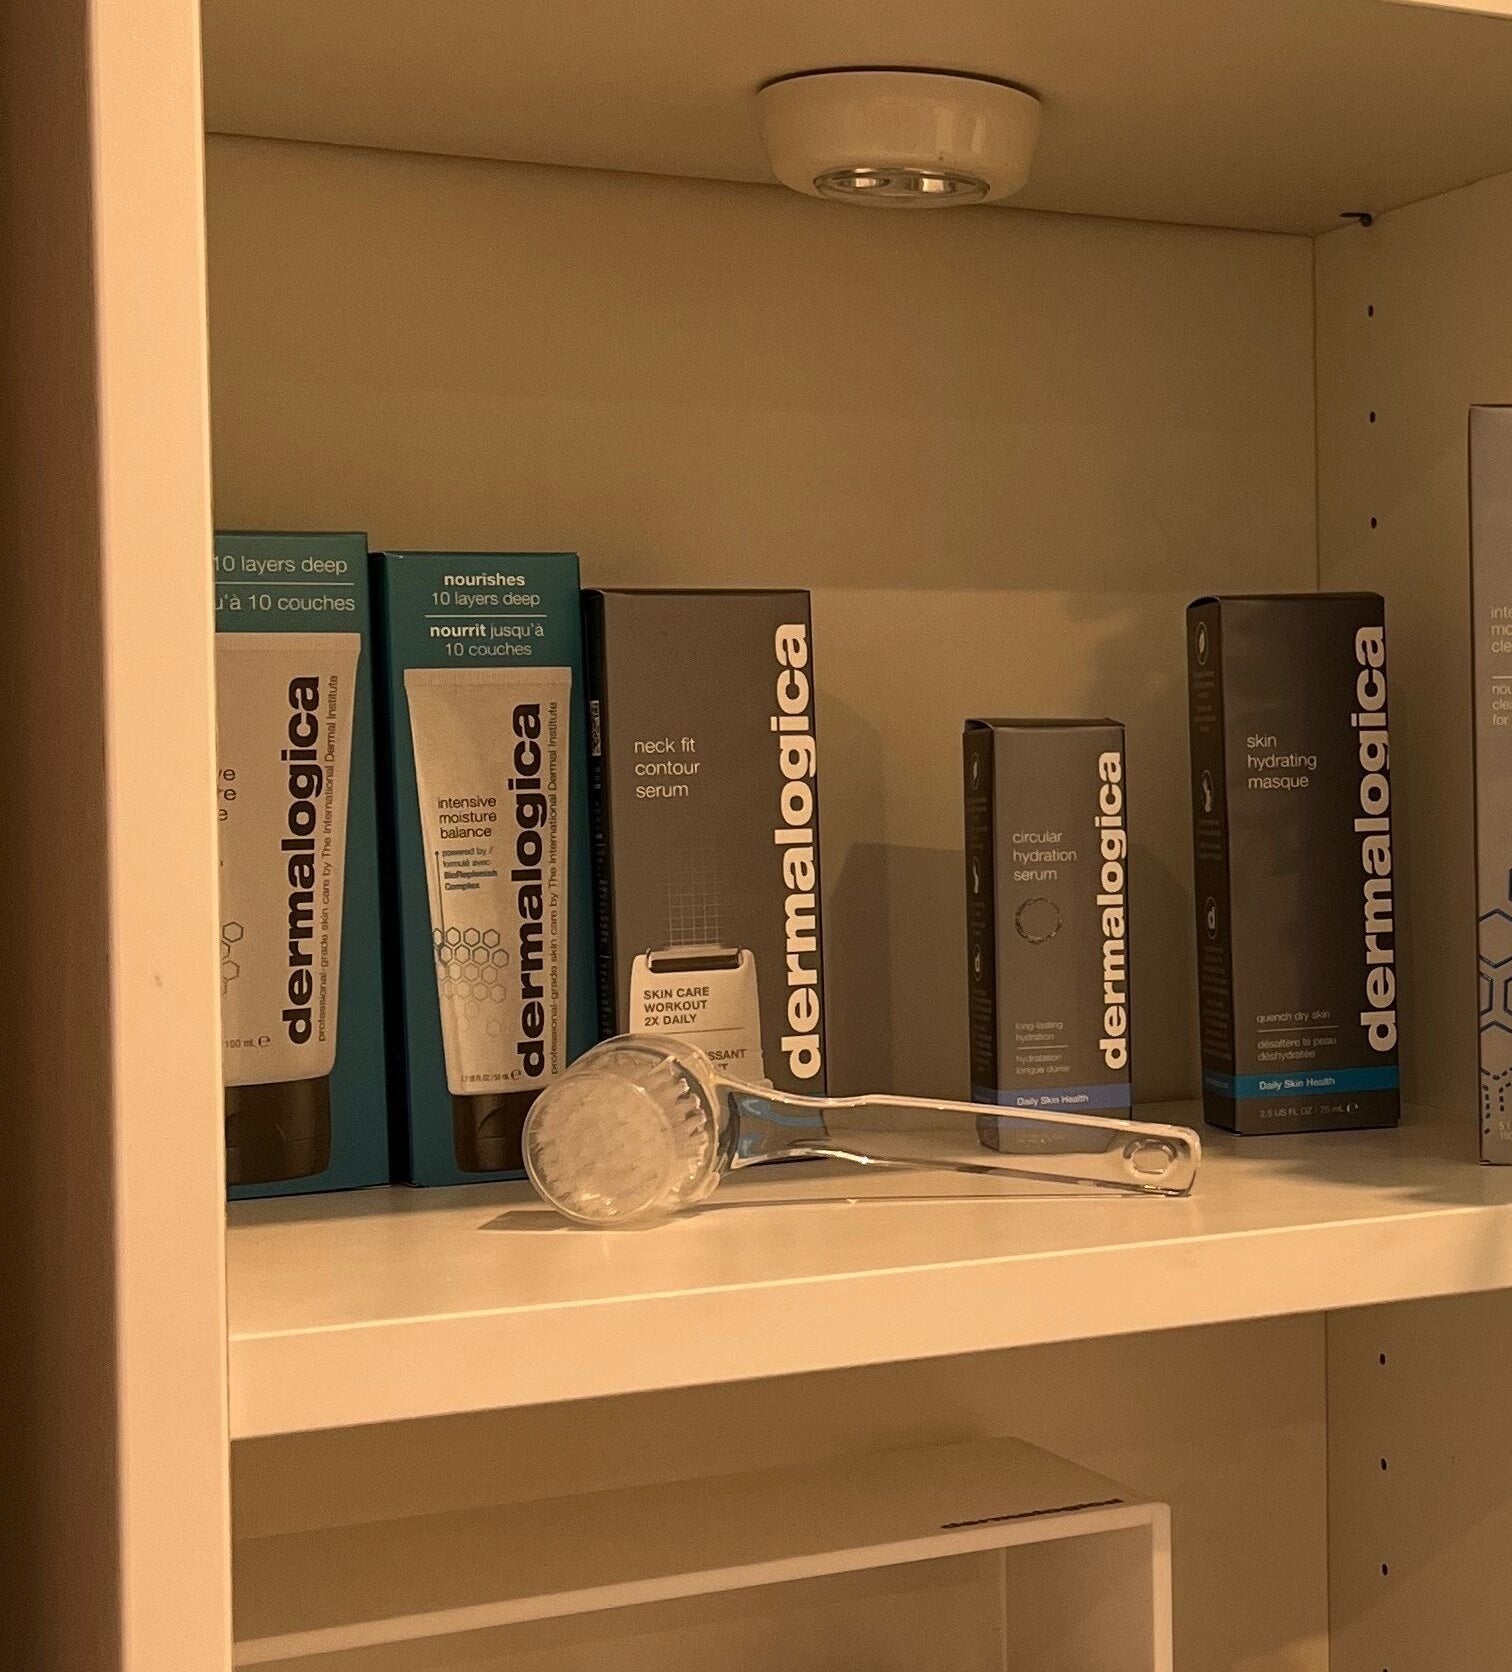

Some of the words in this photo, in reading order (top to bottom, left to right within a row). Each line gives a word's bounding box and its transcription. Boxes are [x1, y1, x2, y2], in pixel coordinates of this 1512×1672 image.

[214, 555, 235, 572] 10
[241, 556, 296, 575] layers
[301, 557, 348, 576] deep
[444, 573, 526, 586] nourishes
[248, 595, 271, 611] 10
[277, 594, 355, 611] couches
[432, 592, 450, 606] 10
[454, 592, 499, 608] layers
[502, 592, 541, 608] deep
[430, 624, 487, 637] nourrit
[490, 622, 544, 639] jusqu'à
[445, 643, 464, 656] 10
[468, 642, 532, 656] couches
[326, 675, 339, 720] Institute
[547, 702, 558, 747] Institute
[1492, 714, 1508, 726] for
[324, 722, 337, 763] Dermal
[634, 737, 676, 753] neck
[681, 736, 696, 752] fit
[1246, 734, 1277, 748] skin
[635, 761, 701, 776] contour
[1247, 753, 1317, 771] hydrating
[547, 750, 558, 791] Dermal
[1247, 774, 1309, 790] masque
[636, 784, 689, 798] serum
[323, 766, 335, 834] International
[438, 796, 497, 809] intensive
[439, 811, 497, 824] moisture
[440, 827, 492, 839] balance
[547, 794, 558, 864] International
[1012, 830, 1063, 844] circular
[1350, 626, 1397, 1052] dermalogica
[321, 837, 332, 858] The
[770, 624, 822, 1079] dermalogica
[281, 676, 322, 1045] dermalogica
[1012, 849, 1077, 865] hydration
[322, 861, 333, 876] by
[1013, 869, 1058, 882] serum
[548, 867, 559, 888] The
[323, 879, 331, 904] care
[508, 703, 547, 1077] dermalogica
[549, 892, 560, 907] by
[321, 907, 330, 931] skin
[1094, 752, 1128, 1070] dermalogica
[550, 910, 560, 936] care
[549, 939, 559, 962] skin
[643, 989, 673, 1000] SKIN
[676, 986, 710, 998] CARE
[644, 1000, 708, 1013] WORKOUT
[644, 1016, 659, 1027] 2X
[663, 1014, 697, 1025] DAILY
[1256, 1012, 1292, 1024] quench
[705, 1049, 747, 1061] SSANT
[1259, 1080, 1282, 1091] Daily
[1284, 1079, 1304, 1089] Skin
[1306, 1077, 1336, 1087] Health
[1016, 1097, 1039, 1106] Daily
[1040, 1096, 1059, 1105] Skin
[1061, 1094, 1089, 1104] Health
